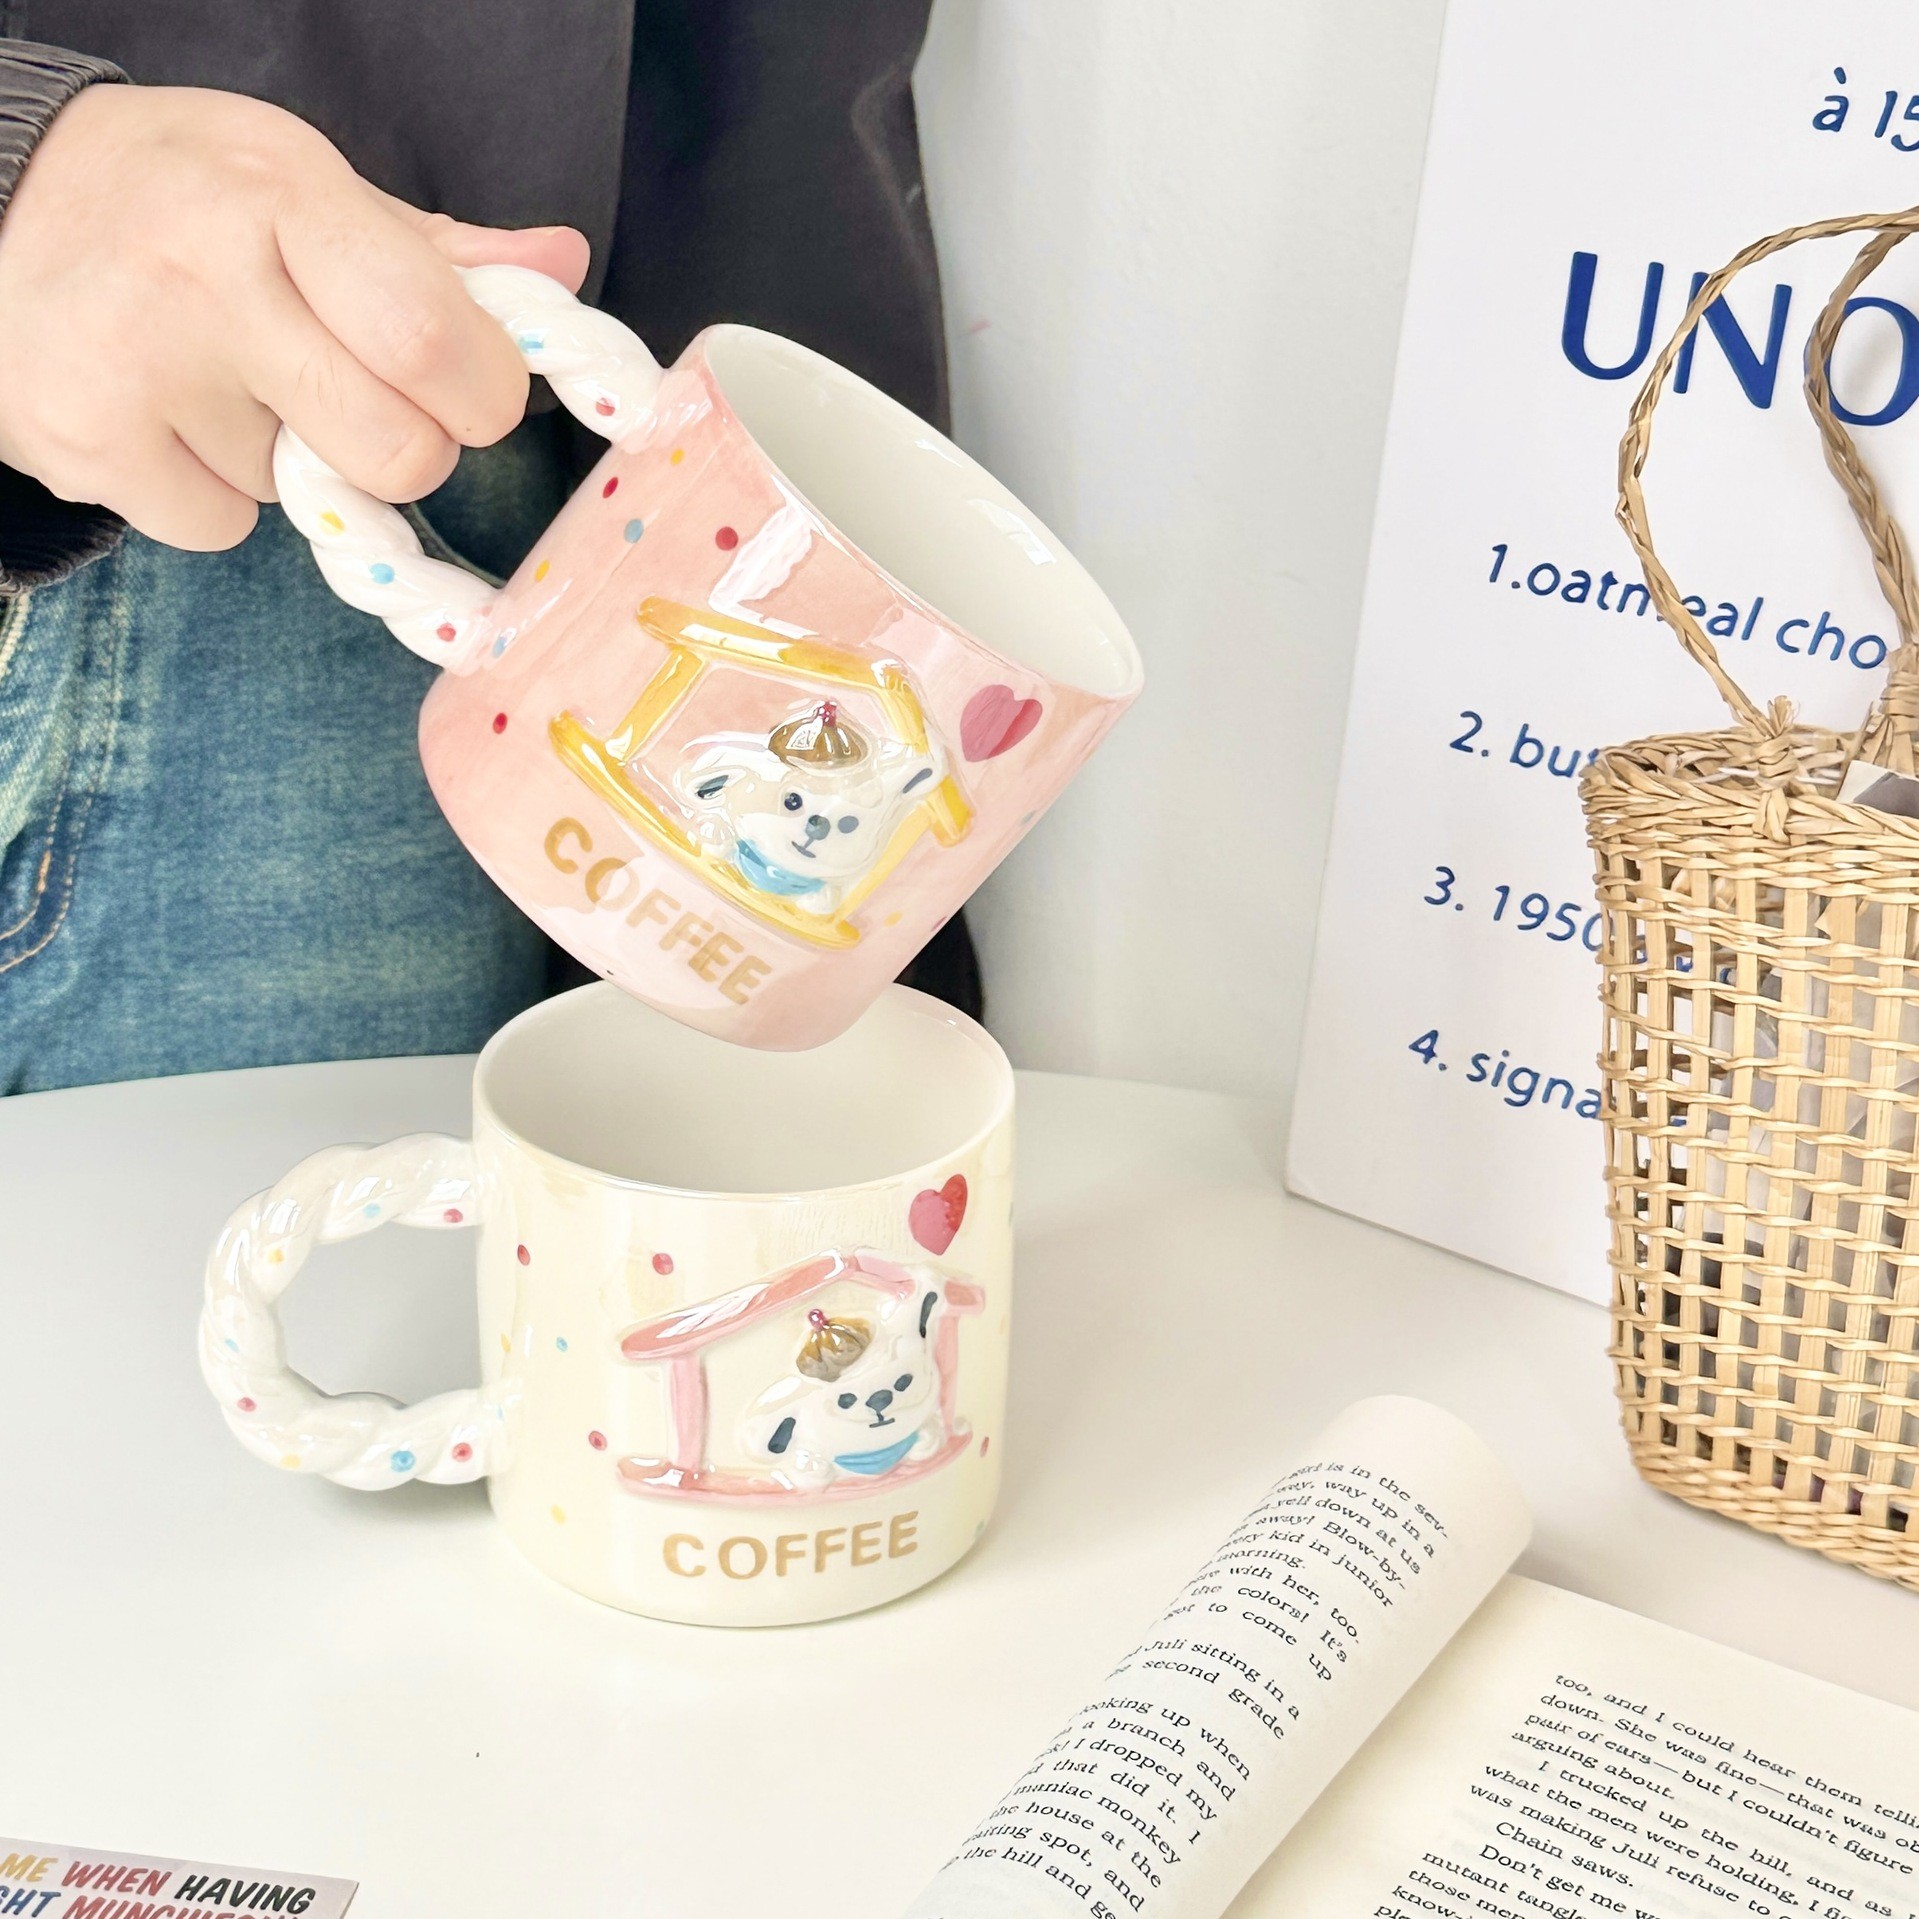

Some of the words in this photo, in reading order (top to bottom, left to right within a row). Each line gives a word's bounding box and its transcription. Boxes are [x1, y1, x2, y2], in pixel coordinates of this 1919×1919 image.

[1812, 66, 1849, 133] à
[1561, 251, 1919, 427] UNO
[1776, 611, 1888, 670] cho
[1449, 710, 1490, 757] 2.
[543, 816, 773, 1006] COFFEE
[1424, 866, 1464, 911] 3.
[1408, 1029, 1448, 1071] 4.
[1315, 1497, 1372, 1530] down
[1376, 1528, 1398, 1549] at
[1400, 1548, 1422, 1575] us
[1325, 1481, 1367, 1499] way
[1371, 1497, 1398, 1520] up
[1401, 1518, 1422, 1541] in
[1423, 1542, 1436, 1559] a
[1350, 1465, 1371, 1480] in
[1379, 1476, 1411, 1502] the
[1414, 1502, 1449, 1540] sev-
[662, 1510, 919, 1580] COFFEE
[1269, 1530, 1305, 1544] kid
[1308, 1538, 1331, 1557] in
[1332, 1554, 1394, 1608] junior
[1322, 1520, 1406, 1591] Blow-by-
[1207, 1602, 1229, 1613] to
[1242, 1610, 1298, 1646] come
[1308, 1653, 1333, 1682] up
[1229, 1565, 1273, 1580] with
[1281, 1574, 1320, 1607] her,
[1330, 1607, 1360, 1645] too.
[1237, 1587, 1311, 1624] colors!
[1319, 1629, 1348, 1663] It's
[1142, 1658, 1221, 1685] second
[1228, 1687, 1286, 1741] grade
[1190, 1643, 1262, 1684] sitting
[1264, 1679, 1286, 1703] in
[1288, 1704, 1301, 1721] a
[1089, 1739, 1184, 1787] dropped
[1185, 1788, 1218, 1822] my
[1107, 1717, 1186, 1758] branch
[1195, 1760, 1237, 1803] and
[1160, 1707, 1191, 1729] up
[1199, 1727, 1252, 1781] when
[1511, 1731, 1600, 1770] arguing
[1604, 1763, 1676, 1800] about.
[1540, 1694, 1605, 1723] down.
[1614, 1717, 1657, 1743] She
[1665, 1740, 1707, 1765] was
[1843, 1815, 1887, 1840] was
[1555, 1674, 1593, 1697] too,
[1603, 1692, 1648, 1716] and
[1654, 1711, 1666, 1723] I
[1672, 1721, 1736, 1753] could
[1742, 1749, 1797, 1778] hear
[1804, 1776, 1863, 1806] them
[1874, 1804, 1919, 1829] telli
[1053, 1758, 1099, 1775] that
[1110, 1771, 1151, 1797] did
[1156, 1798, 1177, 1825] it.
[1188, 1829, 1202, 1846] I
[1096, 1795, 1182, 1866] monkey
[1524, 1714, 1573, 1735] pair
[1577, 1729, 1605, 1744] of
[1727, 1790, 1739, 1803] I
[1742, 1799, 1839, 1846] couldn't
[1843, 1839, 1914, 1876] figure
[1001, 1846, 1044, 1869] hill
[1045, 1864, 1093, 1900] and
[1025, 1801, 1095, 1831] house
[1101, 1829, 1127, 1852] at
[1130, 1851, 1162, 1889] the
[1039, 1830, 1095, 1868] spot,
[1103, 1869, 1146, 1913] and
[1421, 1852, 1510, 1894] mutant
[1470, 1784, 1513, 1808] was
[1518, 1805, 1608, 1849] making
[1611, 1842, 1661, 1869] Juli
[1665, 1864, 1739, 1903] refuse
[1748, 1899, 1772, 1916] to
[1485, 1765, 1541, 1793] what
[1546, 1788, 1583, 1810] the
[1587, 1807, 1639, 1834] men
[1645, 1830, 1700, 1859] were
[1808, 1899, 1820, 1912] I
[1496, 1821, 1564, 1859] Chain
[1571, 1854, 1634, 1888] saws.
[1538, 1760, 1550, 1772] I
[1559, 1769, 1648, 1812] trucked
[1658, 1810, 1690, 1830] up
[1700, 1828, 1740, 1851] the
[1749, 1848, 1793, 1877] hill,
[1806, 1876, 1855, 1901] and
[1864, 1900, 1893, 1917] as
[61, 1860, 172, 1897] WHEN
[173, 1873, 317, 1915] HAVING
[1408, 1869, 1471, 1901] those
[1478, 1844, 1544, 1881] Don't
[1545, 1875, 1586, 1898] get
[1589, 1892, 1627, 1913] me
